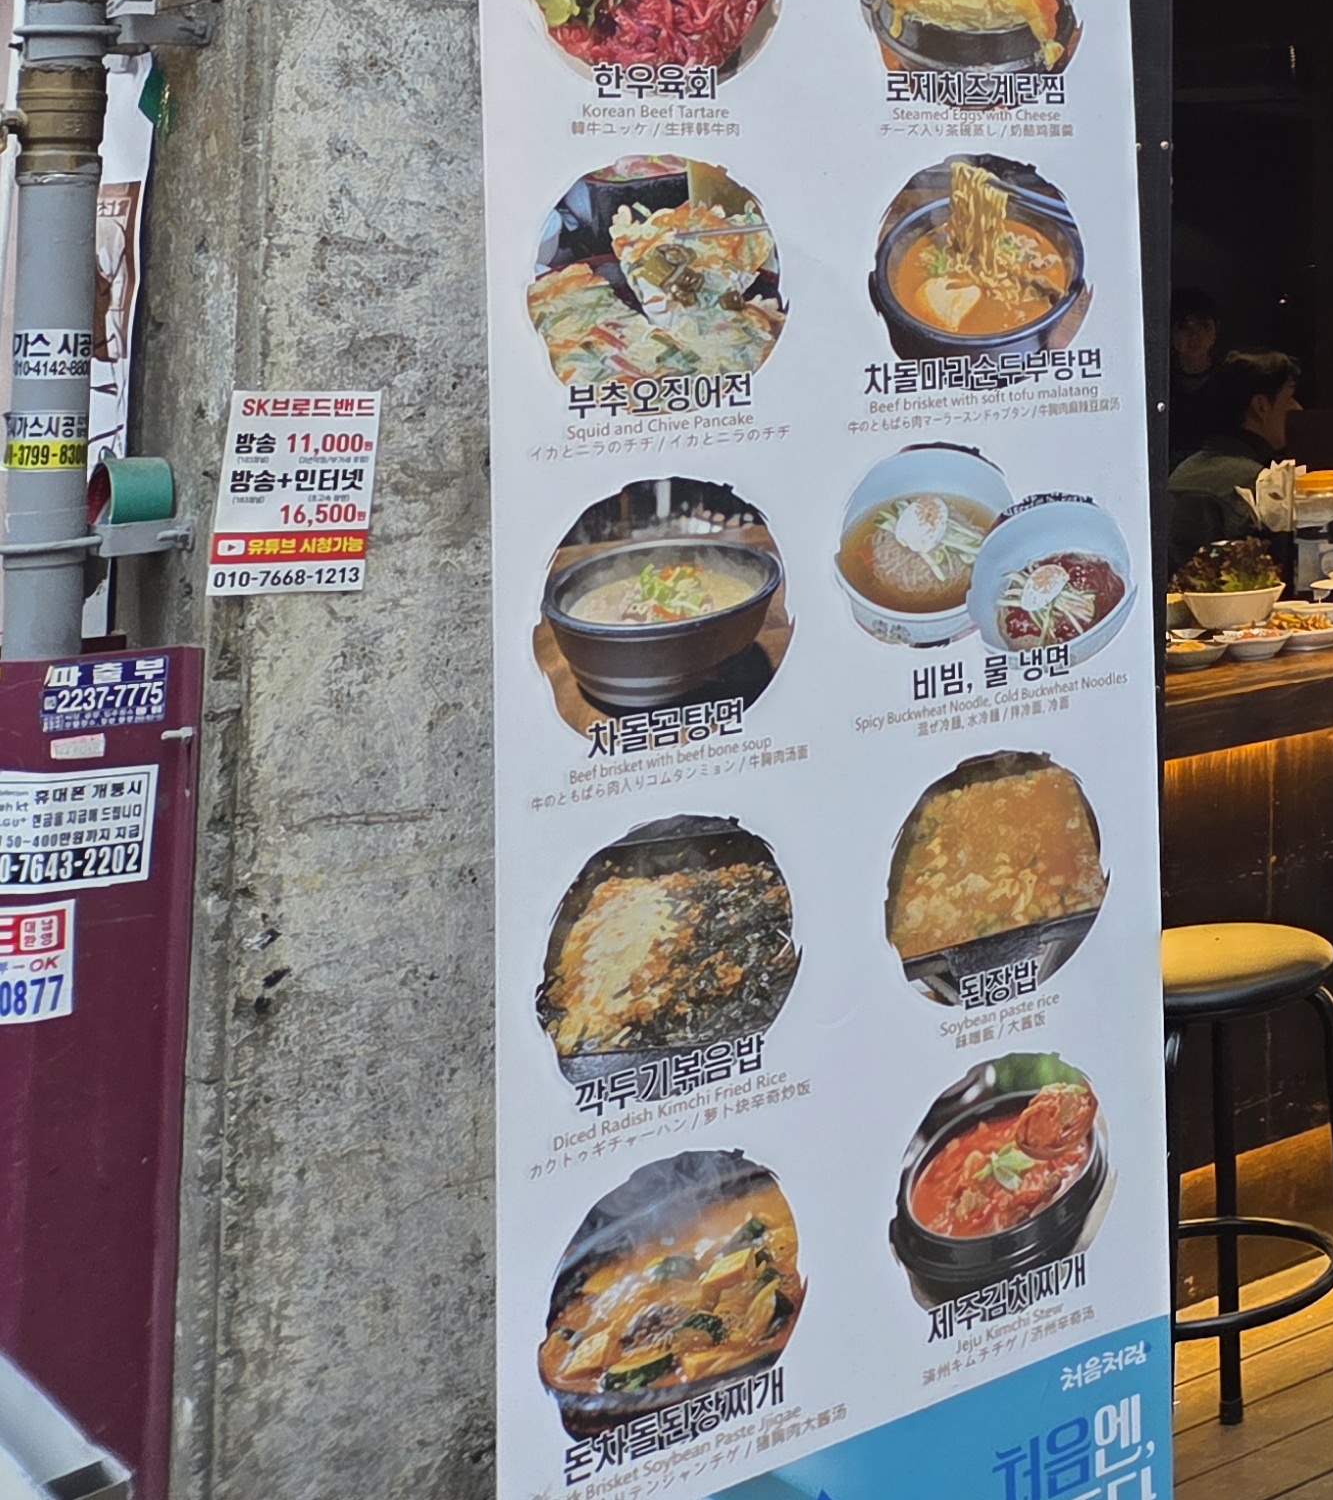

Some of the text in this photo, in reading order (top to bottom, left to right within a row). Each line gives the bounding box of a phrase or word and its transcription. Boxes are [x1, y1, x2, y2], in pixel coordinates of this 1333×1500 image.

[593, 64, 717, 100] 한우육회
[886, 71, 1066, 105] 로제치즈계란찜
[582, 104, 730, 118] Korean Beef Tartare
[892, 107, 1061, 124] Steamed Eggs with Cheese
[864, 348, 1102, 395] 차돌마라순두부탕면
[242, 398, 375, 418] SK브로드밴드
[568, 373, 752, 420] 부추오징어전
[869, 385, 1099, 414] Beef brisket with soft tofu malatang
[567, 411, 754, 441] Squid and Chive Pancake
[235, 433, 374, 457] 방송 11,000원
[230, 468, 364, 493] 방송+인터넷
[280, 503, 367, 527] 16,500원
[248, 536, 364, 556] 유튜브 시청가능
[213, 567, 360, 589] 010-7668-1213
[913, 644, 1070, 701] 비빔, 물 냉면
[56, 681, 164, 713] 2237-7775
[855, 713, 885, 734] Spicy
[887, 703, 947, 725] Buckwheat
[994, 690, 1019, 706] Cold
[1021, 680, 1079, 701] Buckwheat
[1081, 671, 1128, 690] Noodles
[588, 697, 744, 759] 차돌곰탕면
[569, 736, 772, 785] Beef brisket with beef bone soup
[15, 801, 29, 812] kt
[34, 785, 86, 805] 휴대폰
[101, 803, 142, 821] 드립니다
[6, 824, 140, 849] 50~400만원까지 지급
[29, 954, 61, 973] OK
[0, 974, 64, 1016] 0877
[961, 960, 1038, 1010] 된장밥
[940, 992, 1060, 1037] Soybean paste rice
[575, 1035, 765, 1117] 깍두기볶음밥
[553, 1070, 787, 1152] Diced Radish Kimchi Fried Rice
[927, 1253, 1087, 1343] 제주김치찌개
[956, 1303, 1065, 1355] Jeju Kimchi Stew
[1060, 1340, 1148, 1392] 처음처럼
[563, 1366, 784, 1487] 돈차돌된장찌개
[585, 1467, 639, 1497] Brisket
[643, 1441, 712, 1477] Soybean
[714, 1425, 755, 1447] Paste
[758, 1405, 803, 1434] Jjigae
